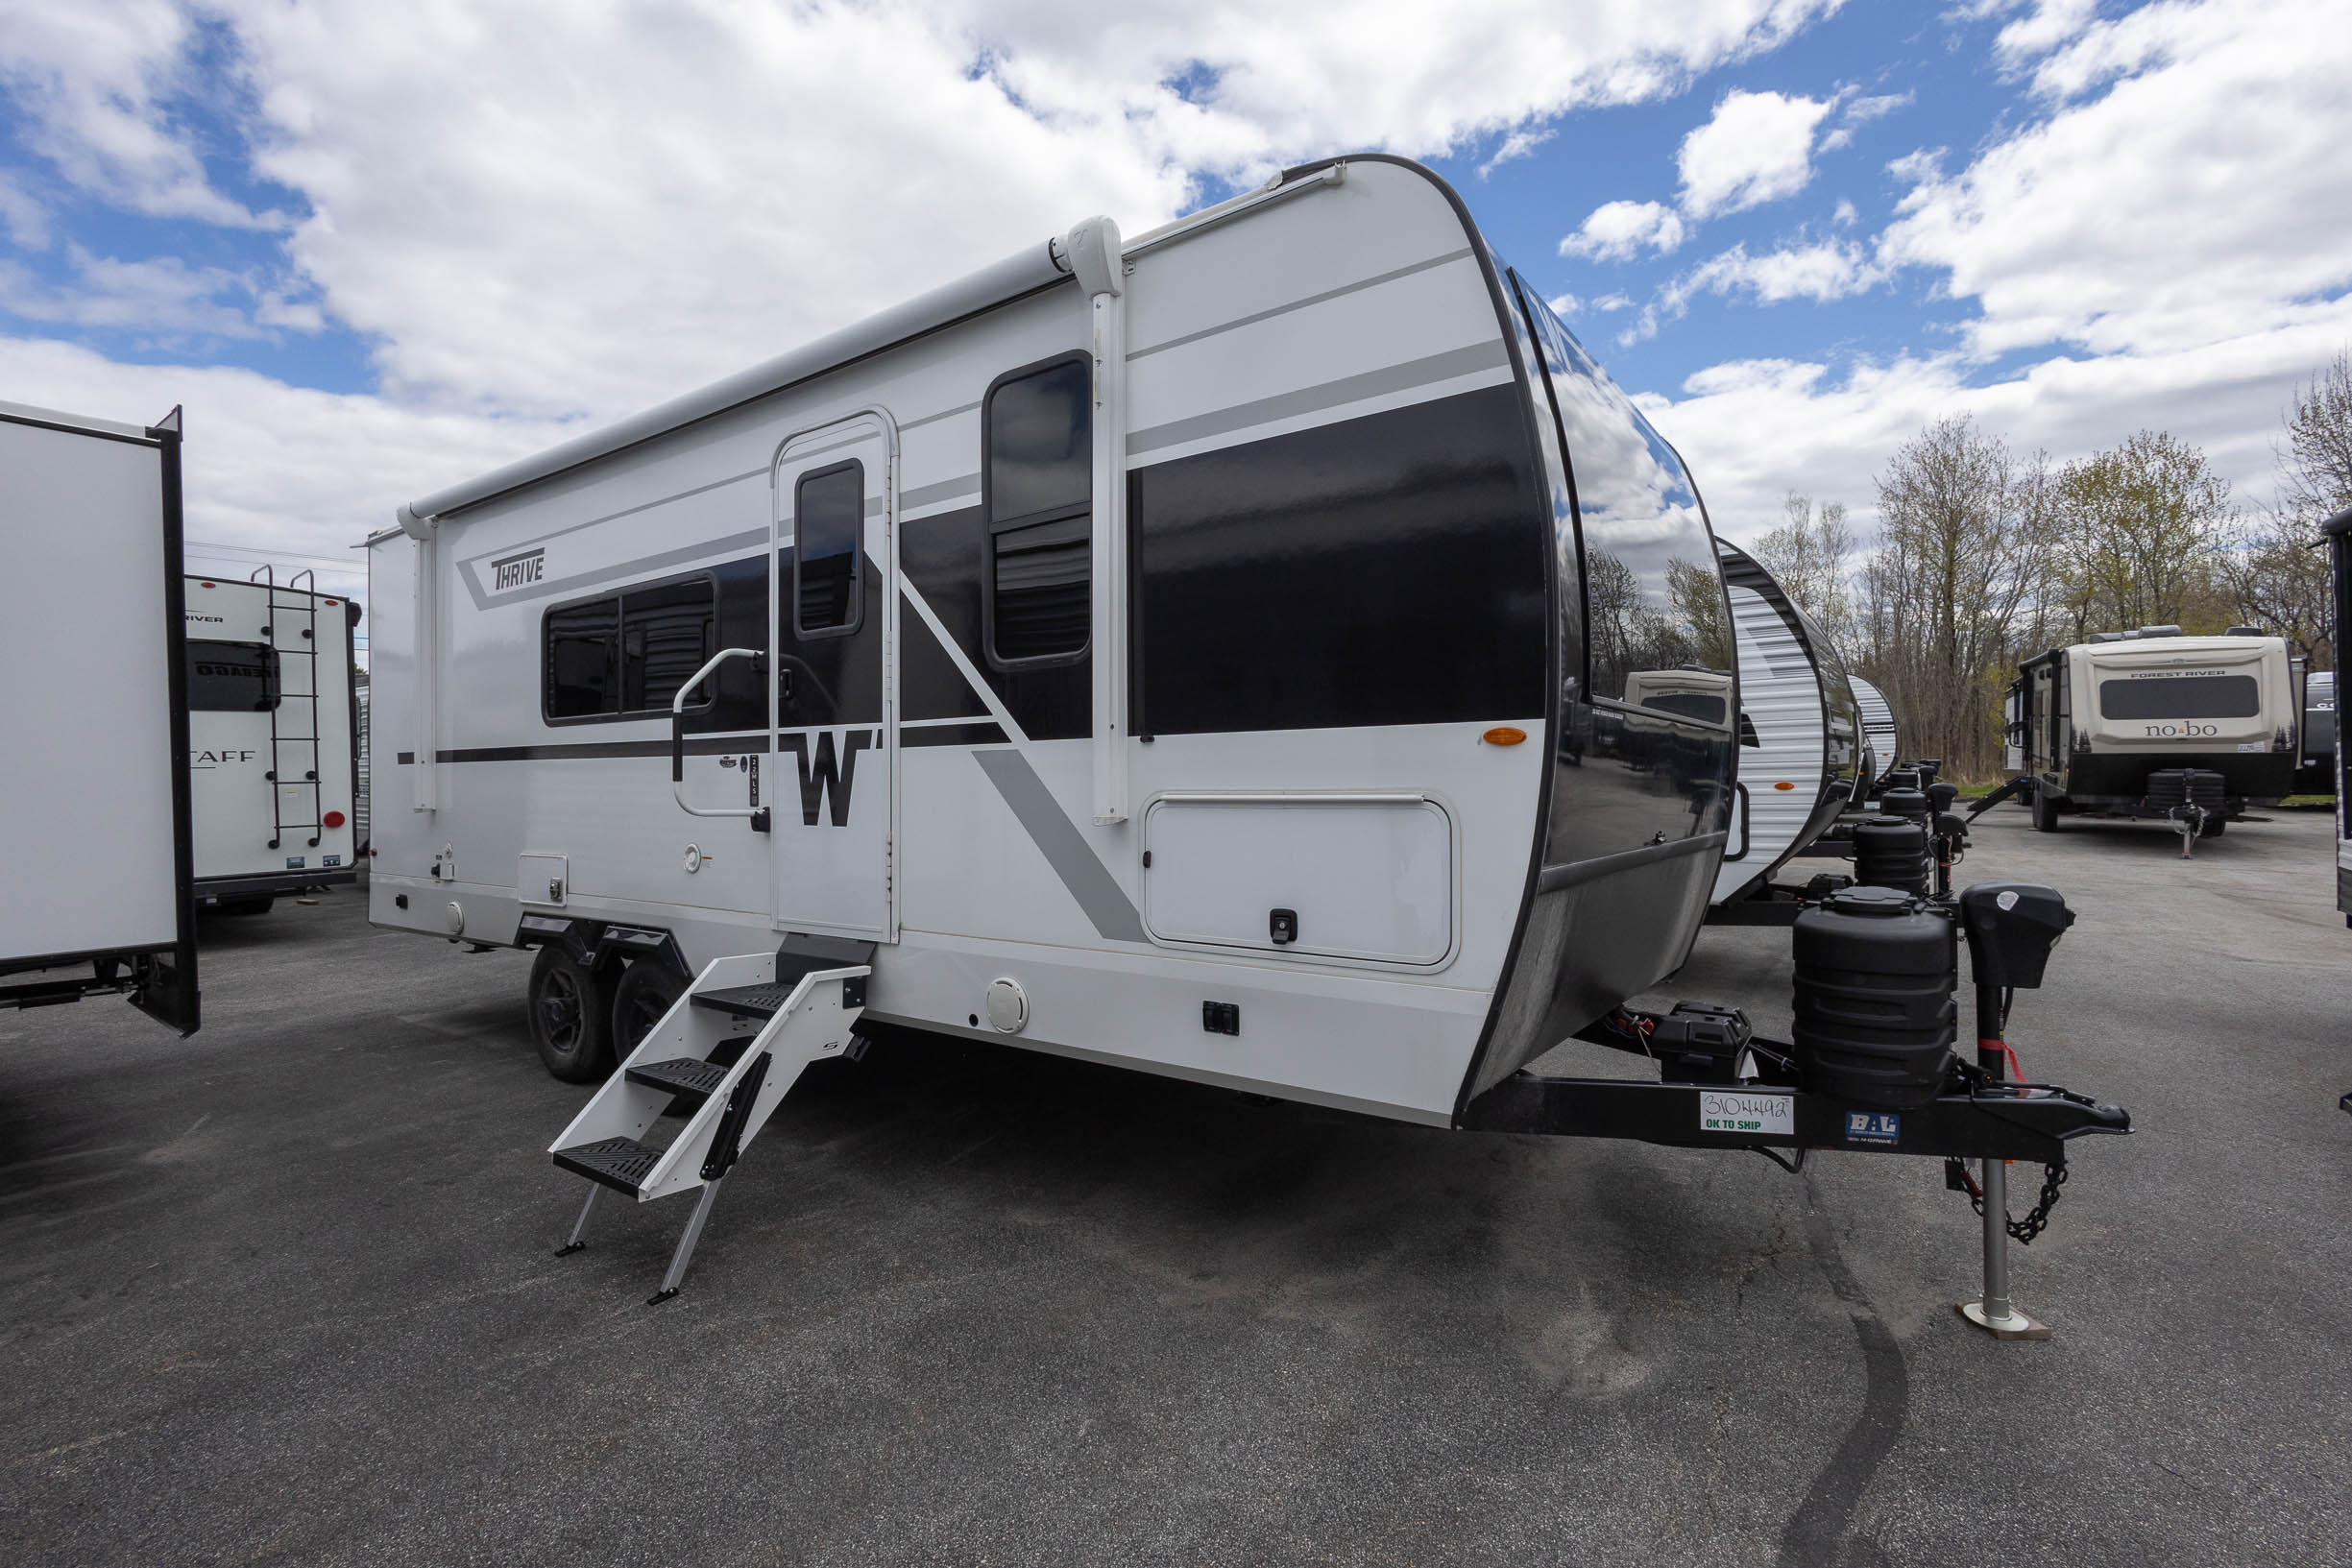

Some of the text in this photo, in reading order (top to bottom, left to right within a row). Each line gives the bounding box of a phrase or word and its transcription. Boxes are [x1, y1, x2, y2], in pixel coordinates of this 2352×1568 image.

[491, 546, 545, 591] THRIVE
[1704, 1095, 1787, 1118] 3104492
[1706, 1119, 1761, 1130] OK TO SHIP
